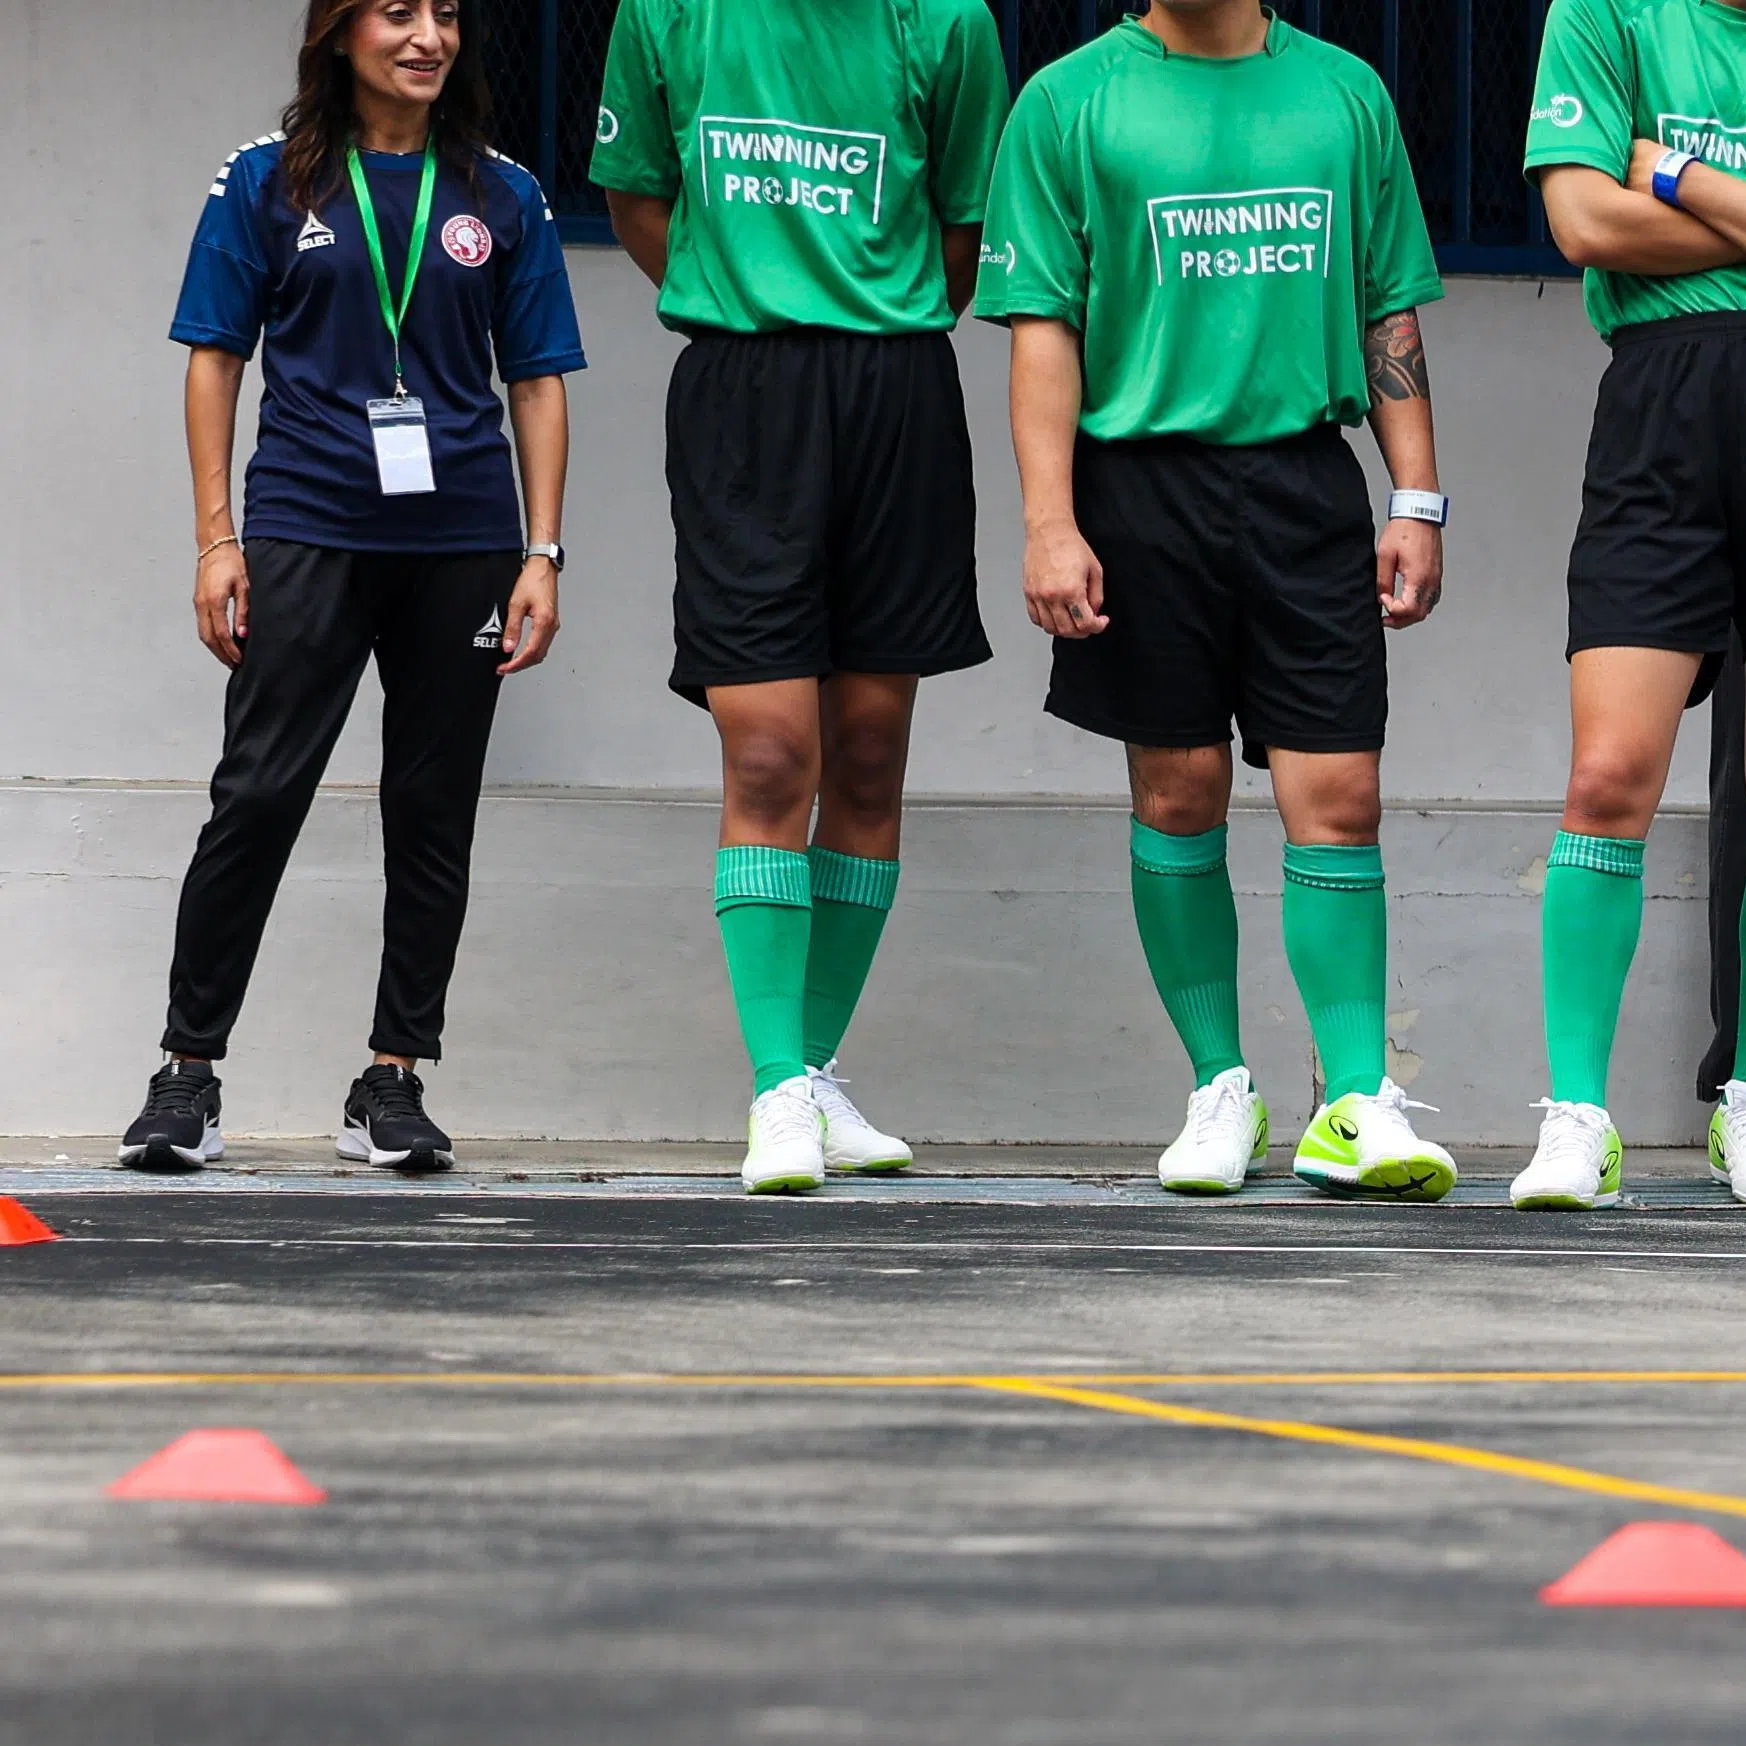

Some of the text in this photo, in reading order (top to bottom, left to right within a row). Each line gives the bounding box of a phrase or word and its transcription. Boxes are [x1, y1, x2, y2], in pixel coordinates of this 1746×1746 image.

[708, 130, 869, 175] TWINNING
[724, 173, 853, 215] PROJECT
[1161, 201, 1322, 238] TWINNING
[297, 234, 336, 252] SELECT
[1180, 243, 1315, 279] PROJECT
[473, 636, 500, 648] SELE
